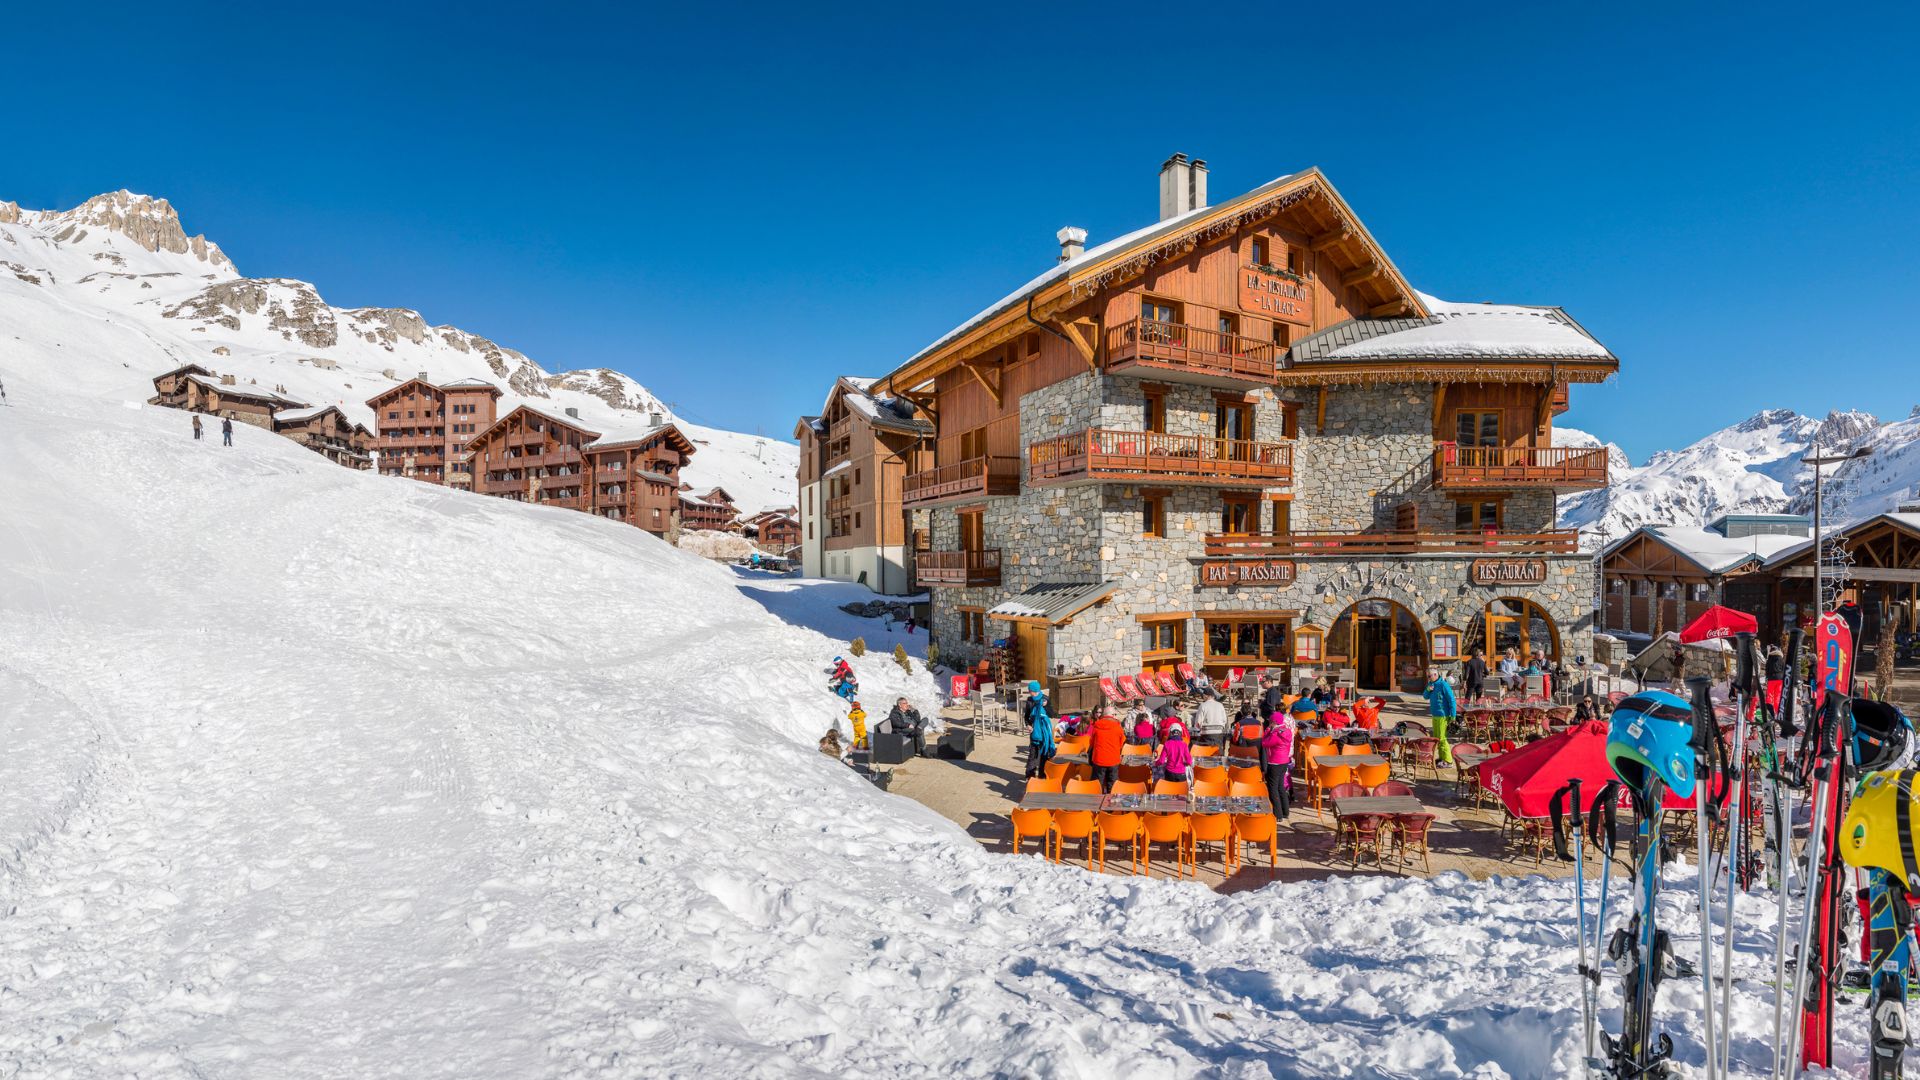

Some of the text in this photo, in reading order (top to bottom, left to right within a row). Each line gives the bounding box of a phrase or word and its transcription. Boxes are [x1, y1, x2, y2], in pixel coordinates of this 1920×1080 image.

[1248, 274, 1260, 290] BAR
[1267, 279, 1306, 303] RESTAURANT
[1261, 295, 1271, 310] LA
[1274, 298, 1294, 316] PLACE
[1209, 566, 1228, 581] BAR
[1240, 565, 1290, 580] BRASSERIE
[1331, 567, 1415, 592] LA PLACE
[1480, 564, 1541, 580] RESTAURANT
[1825, 640, 1839, 690] AD
